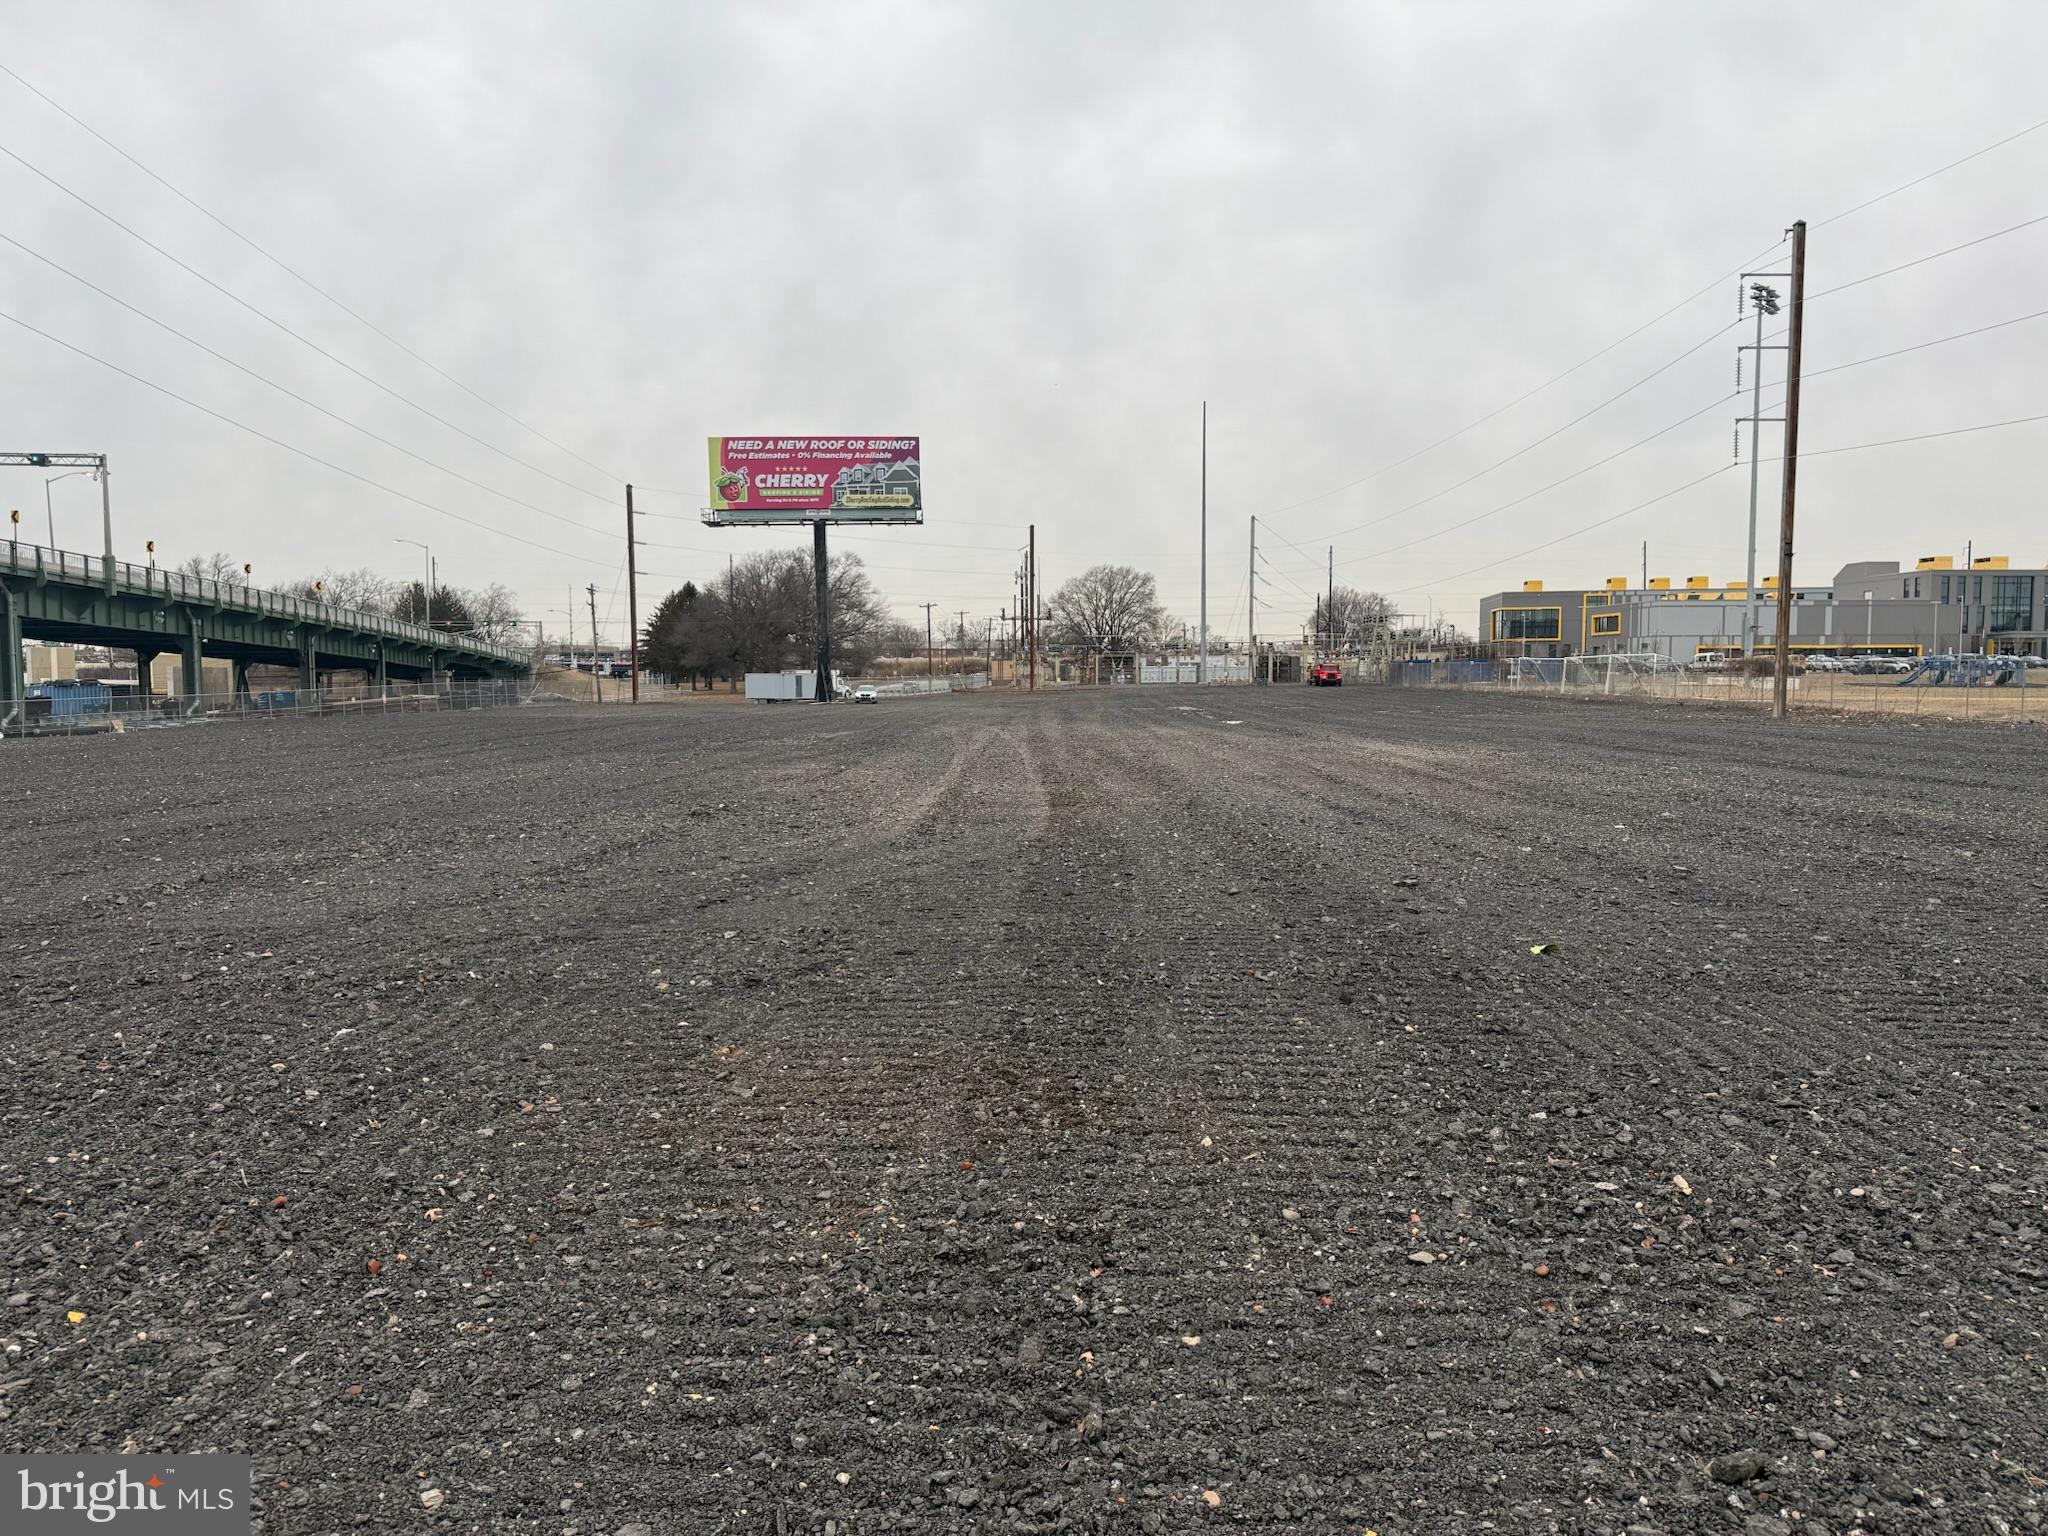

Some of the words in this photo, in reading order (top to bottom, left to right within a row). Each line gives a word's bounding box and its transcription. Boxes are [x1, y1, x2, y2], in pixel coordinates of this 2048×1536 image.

[728, 440, 763, 450] NEED
[765, 440, 774, 450] A
[777, 440, 808, 450] NEW
[810, 440, 846, 450] ROOF
[847, 440, 866, 450] OR
[867, 440, 916, 450] SIDING?
[755, 473, 829, 488] CHERRY
